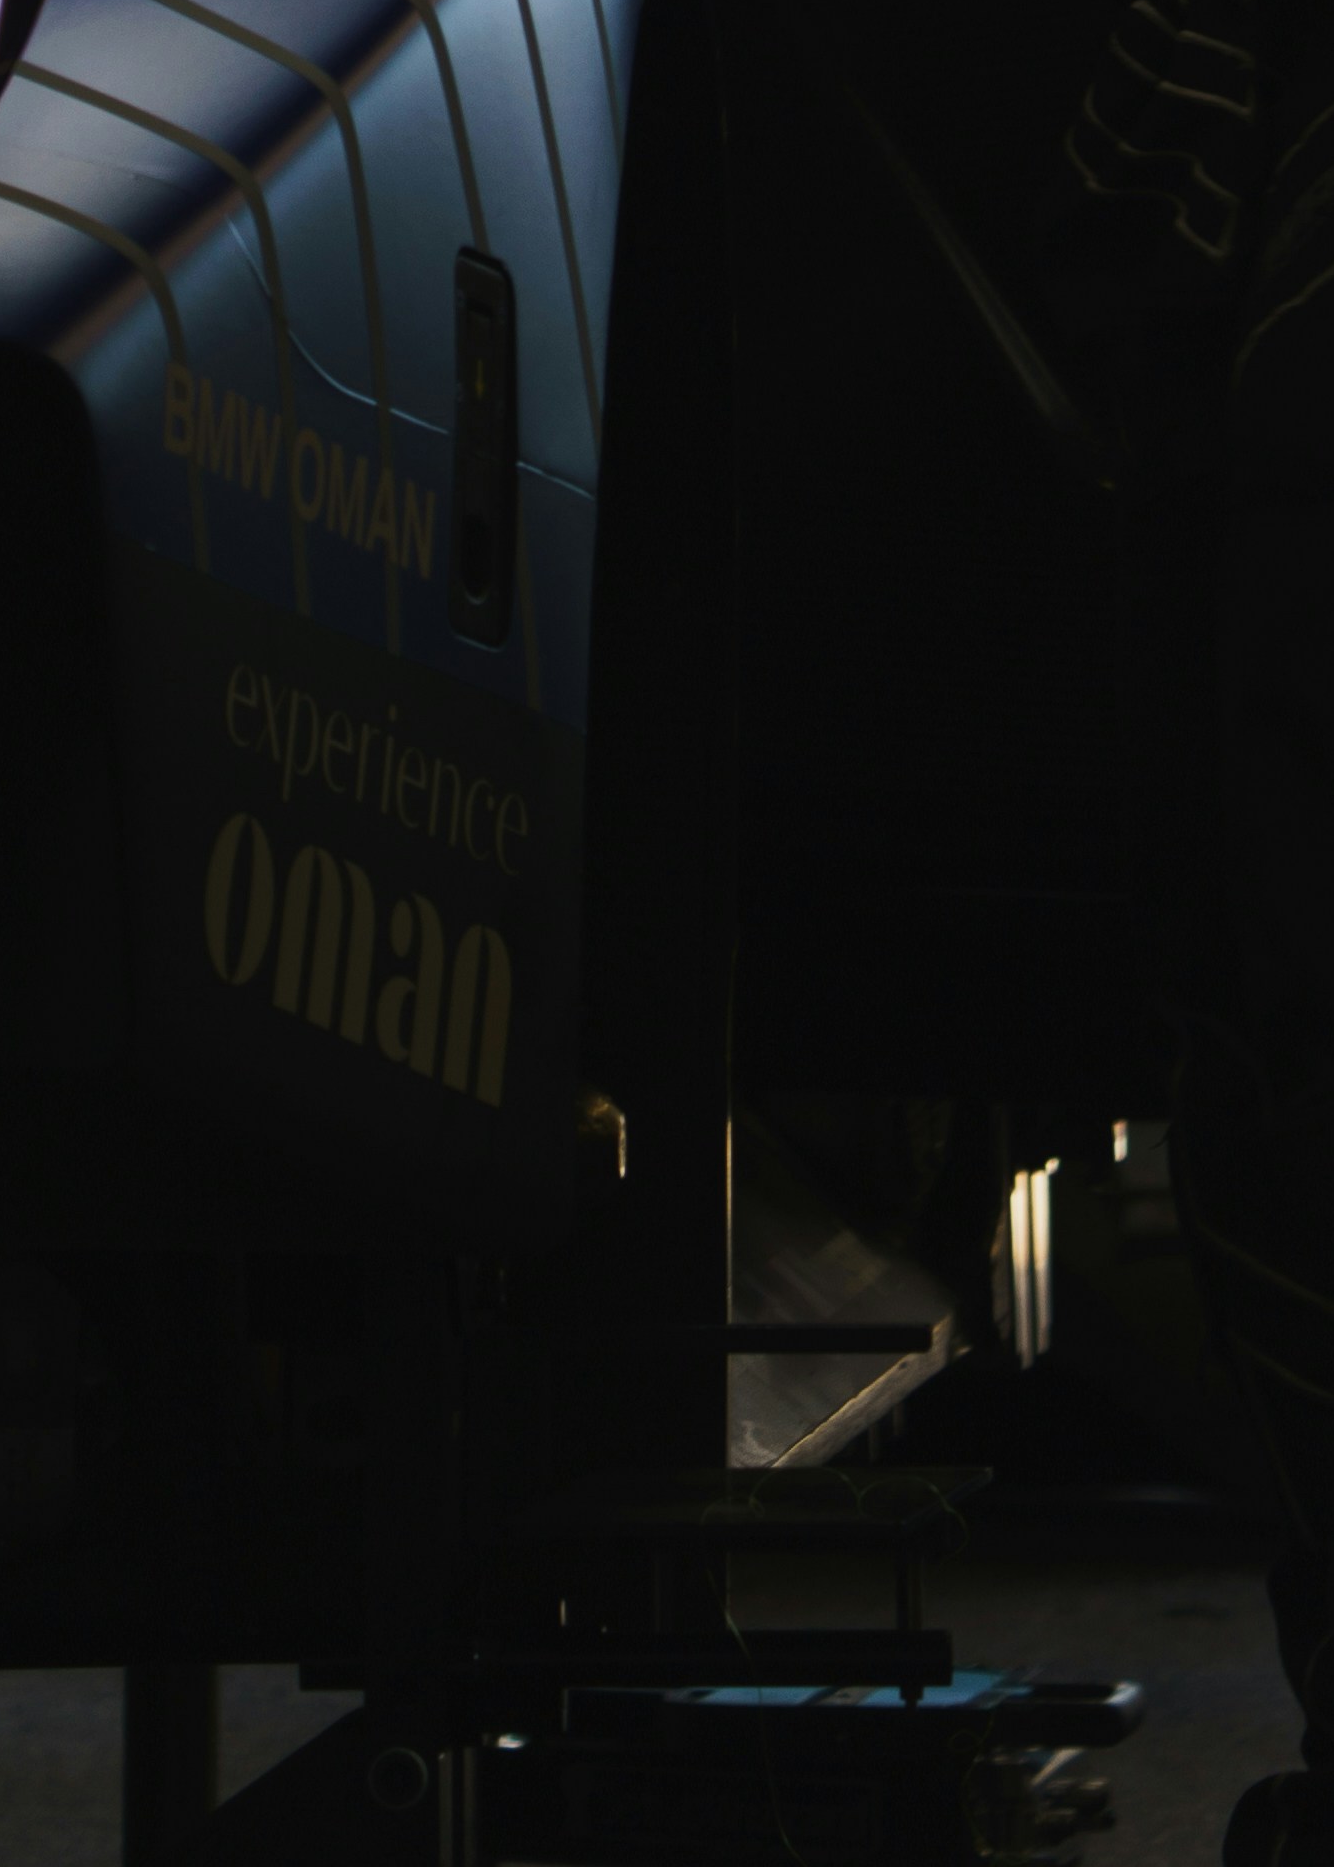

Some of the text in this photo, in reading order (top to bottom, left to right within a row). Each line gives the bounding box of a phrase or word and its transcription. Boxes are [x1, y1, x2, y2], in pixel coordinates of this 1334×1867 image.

[164, 359, 437, 582] BMW OMAN
[225, 662, 530, 877] experience
